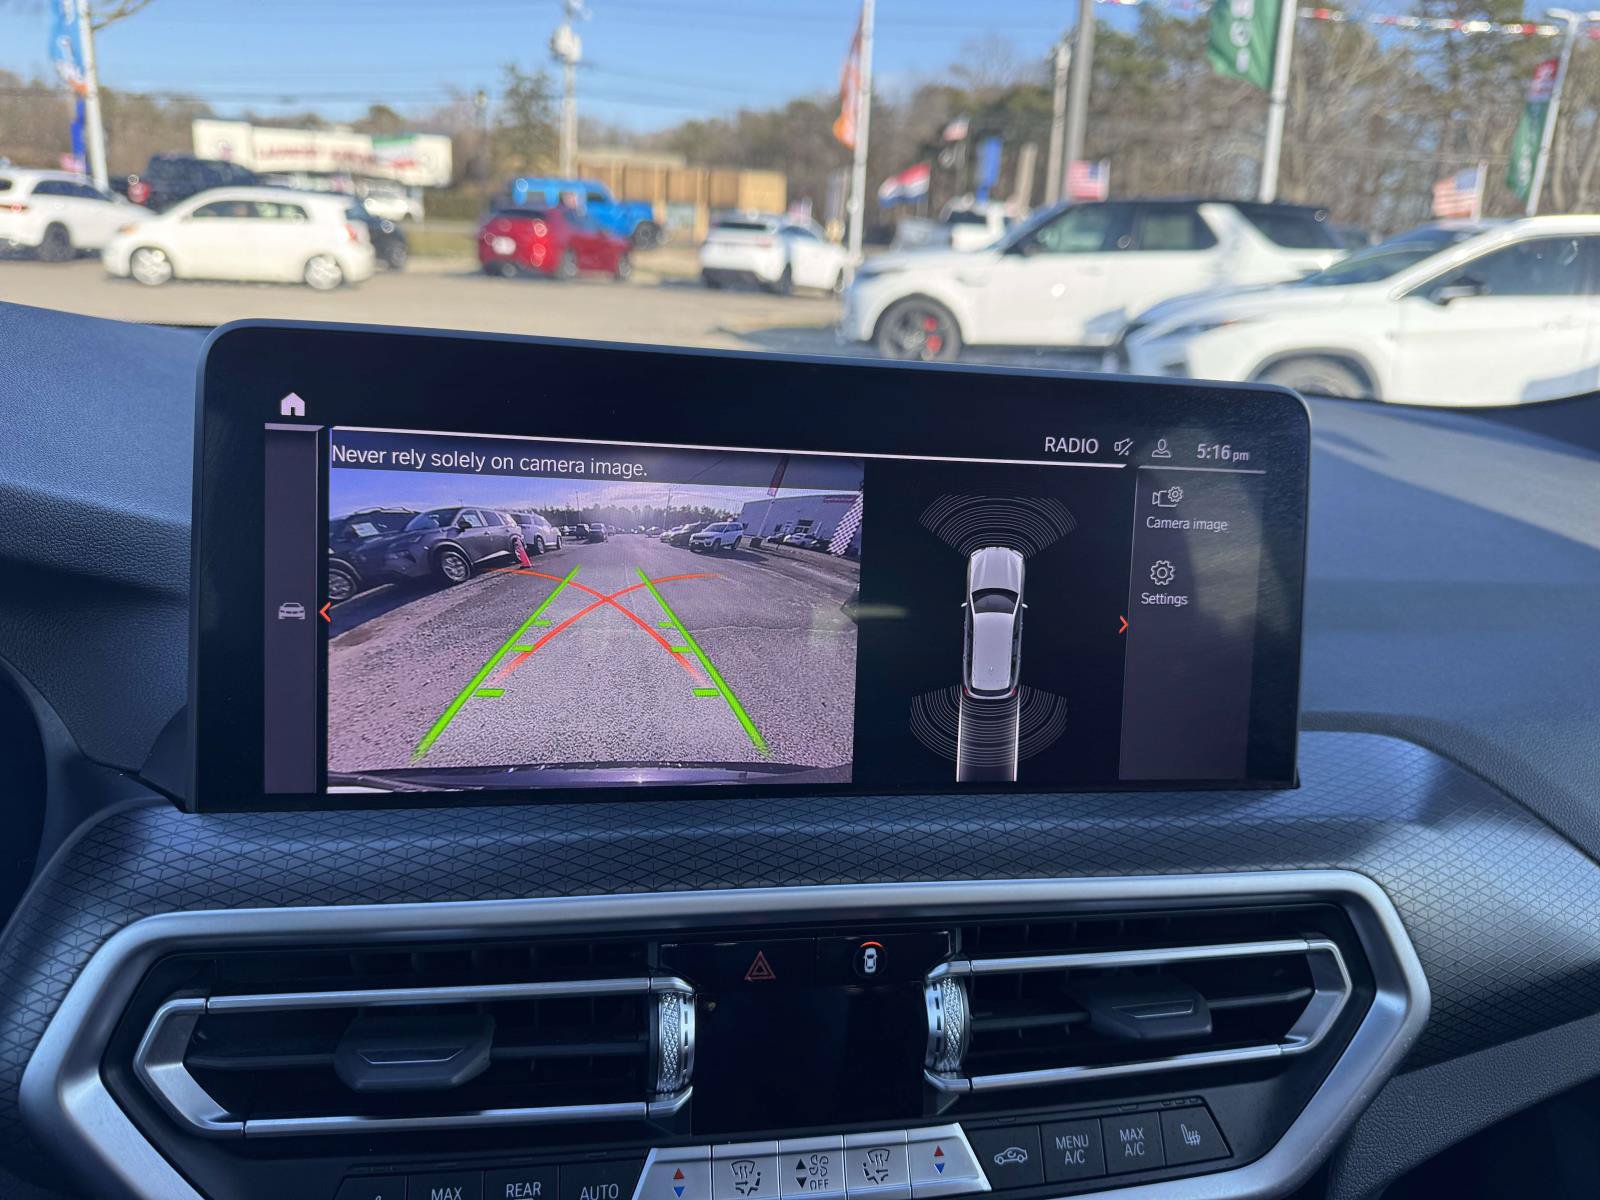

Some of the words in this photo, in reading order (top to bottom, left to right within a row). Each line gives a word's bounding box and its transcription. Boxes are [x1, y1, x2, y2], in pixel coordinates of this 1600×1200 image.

[1044, 437, 1099, 454] RADIO
[1197, 443, 1231, 460] 5:16
[1232, 451, 1249, 463] pm
[332, 445, 387, 464] Never
[391, 448, 426, 469] rely
[431, 451, 485, 472] solely
[491, 457, 514, 471] on
[519, 457, 585, 474] camera
[590, 458, 648, 479] image.
[1146, 516, 1190, 530] Camera
[1192, 518, 1228, 533] image
[1140, 592, 1188, 607] Settings
[1055, 1134, 1089, 1150] MENU
[1120, 1127, 1145, 1142] MAX
[1064, 1149, 1085, 1165] A/C
[1124, 1142, 1145, 1157] A/C
[505, 1181, 542, 1198] REAR
[580, 1184, 619, 1200] AUTO
[809, 1179, 829, 1190] OFF
[431, 1187, 463, 1200] MAX
